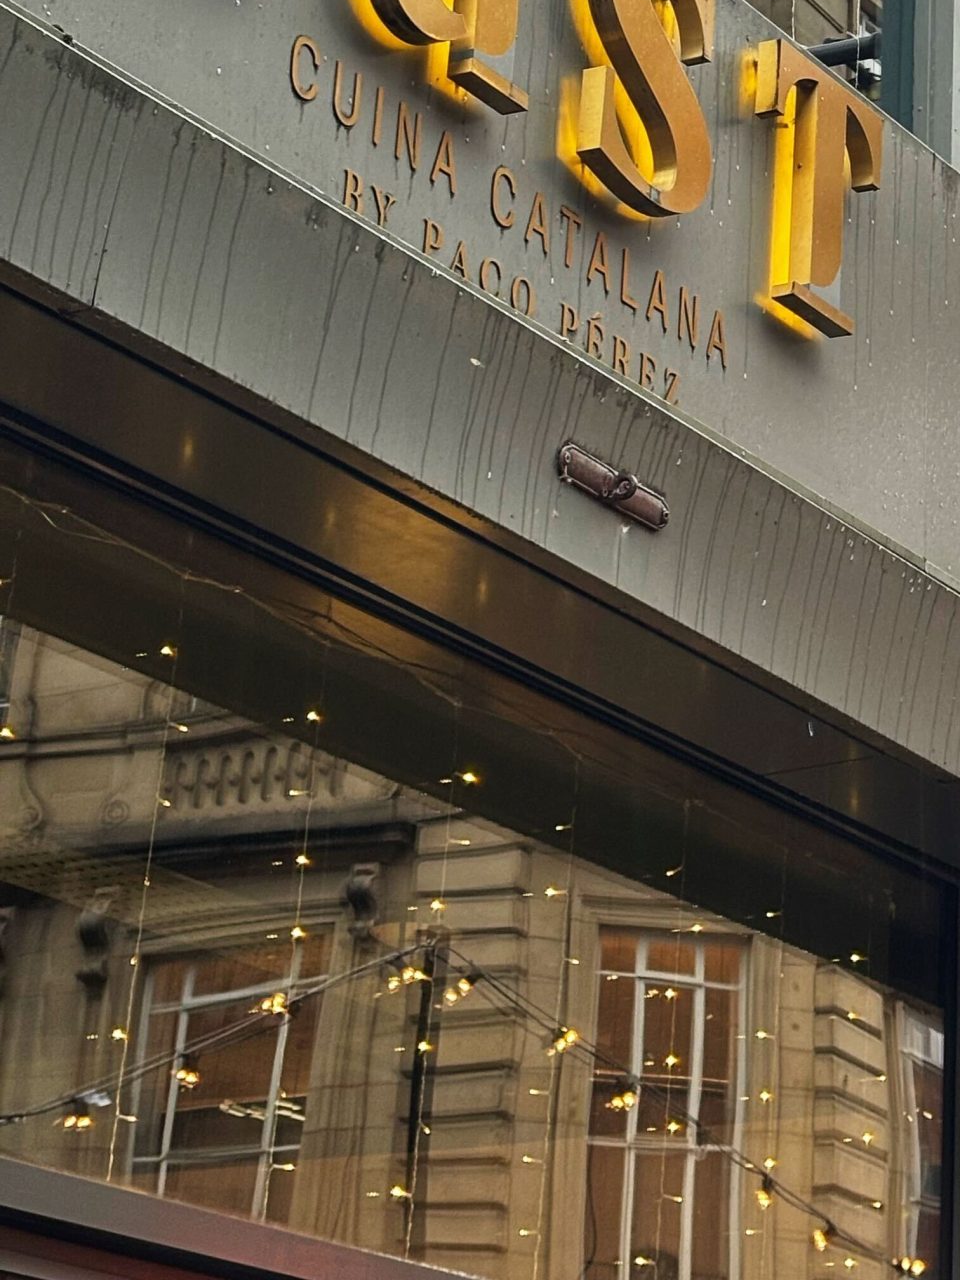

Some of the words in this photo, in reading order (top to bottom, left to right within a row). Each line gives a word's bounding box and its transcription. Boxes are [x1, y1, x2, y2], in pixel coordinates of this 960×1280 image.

[290, 35, 457, 198] CUINA
[491, 165, 729, 369] CATALANA
[343, 168, 397, 227] BY
[423, 218, 536, 317] PACO
[561, 301, 681, 406] PÉREZ
